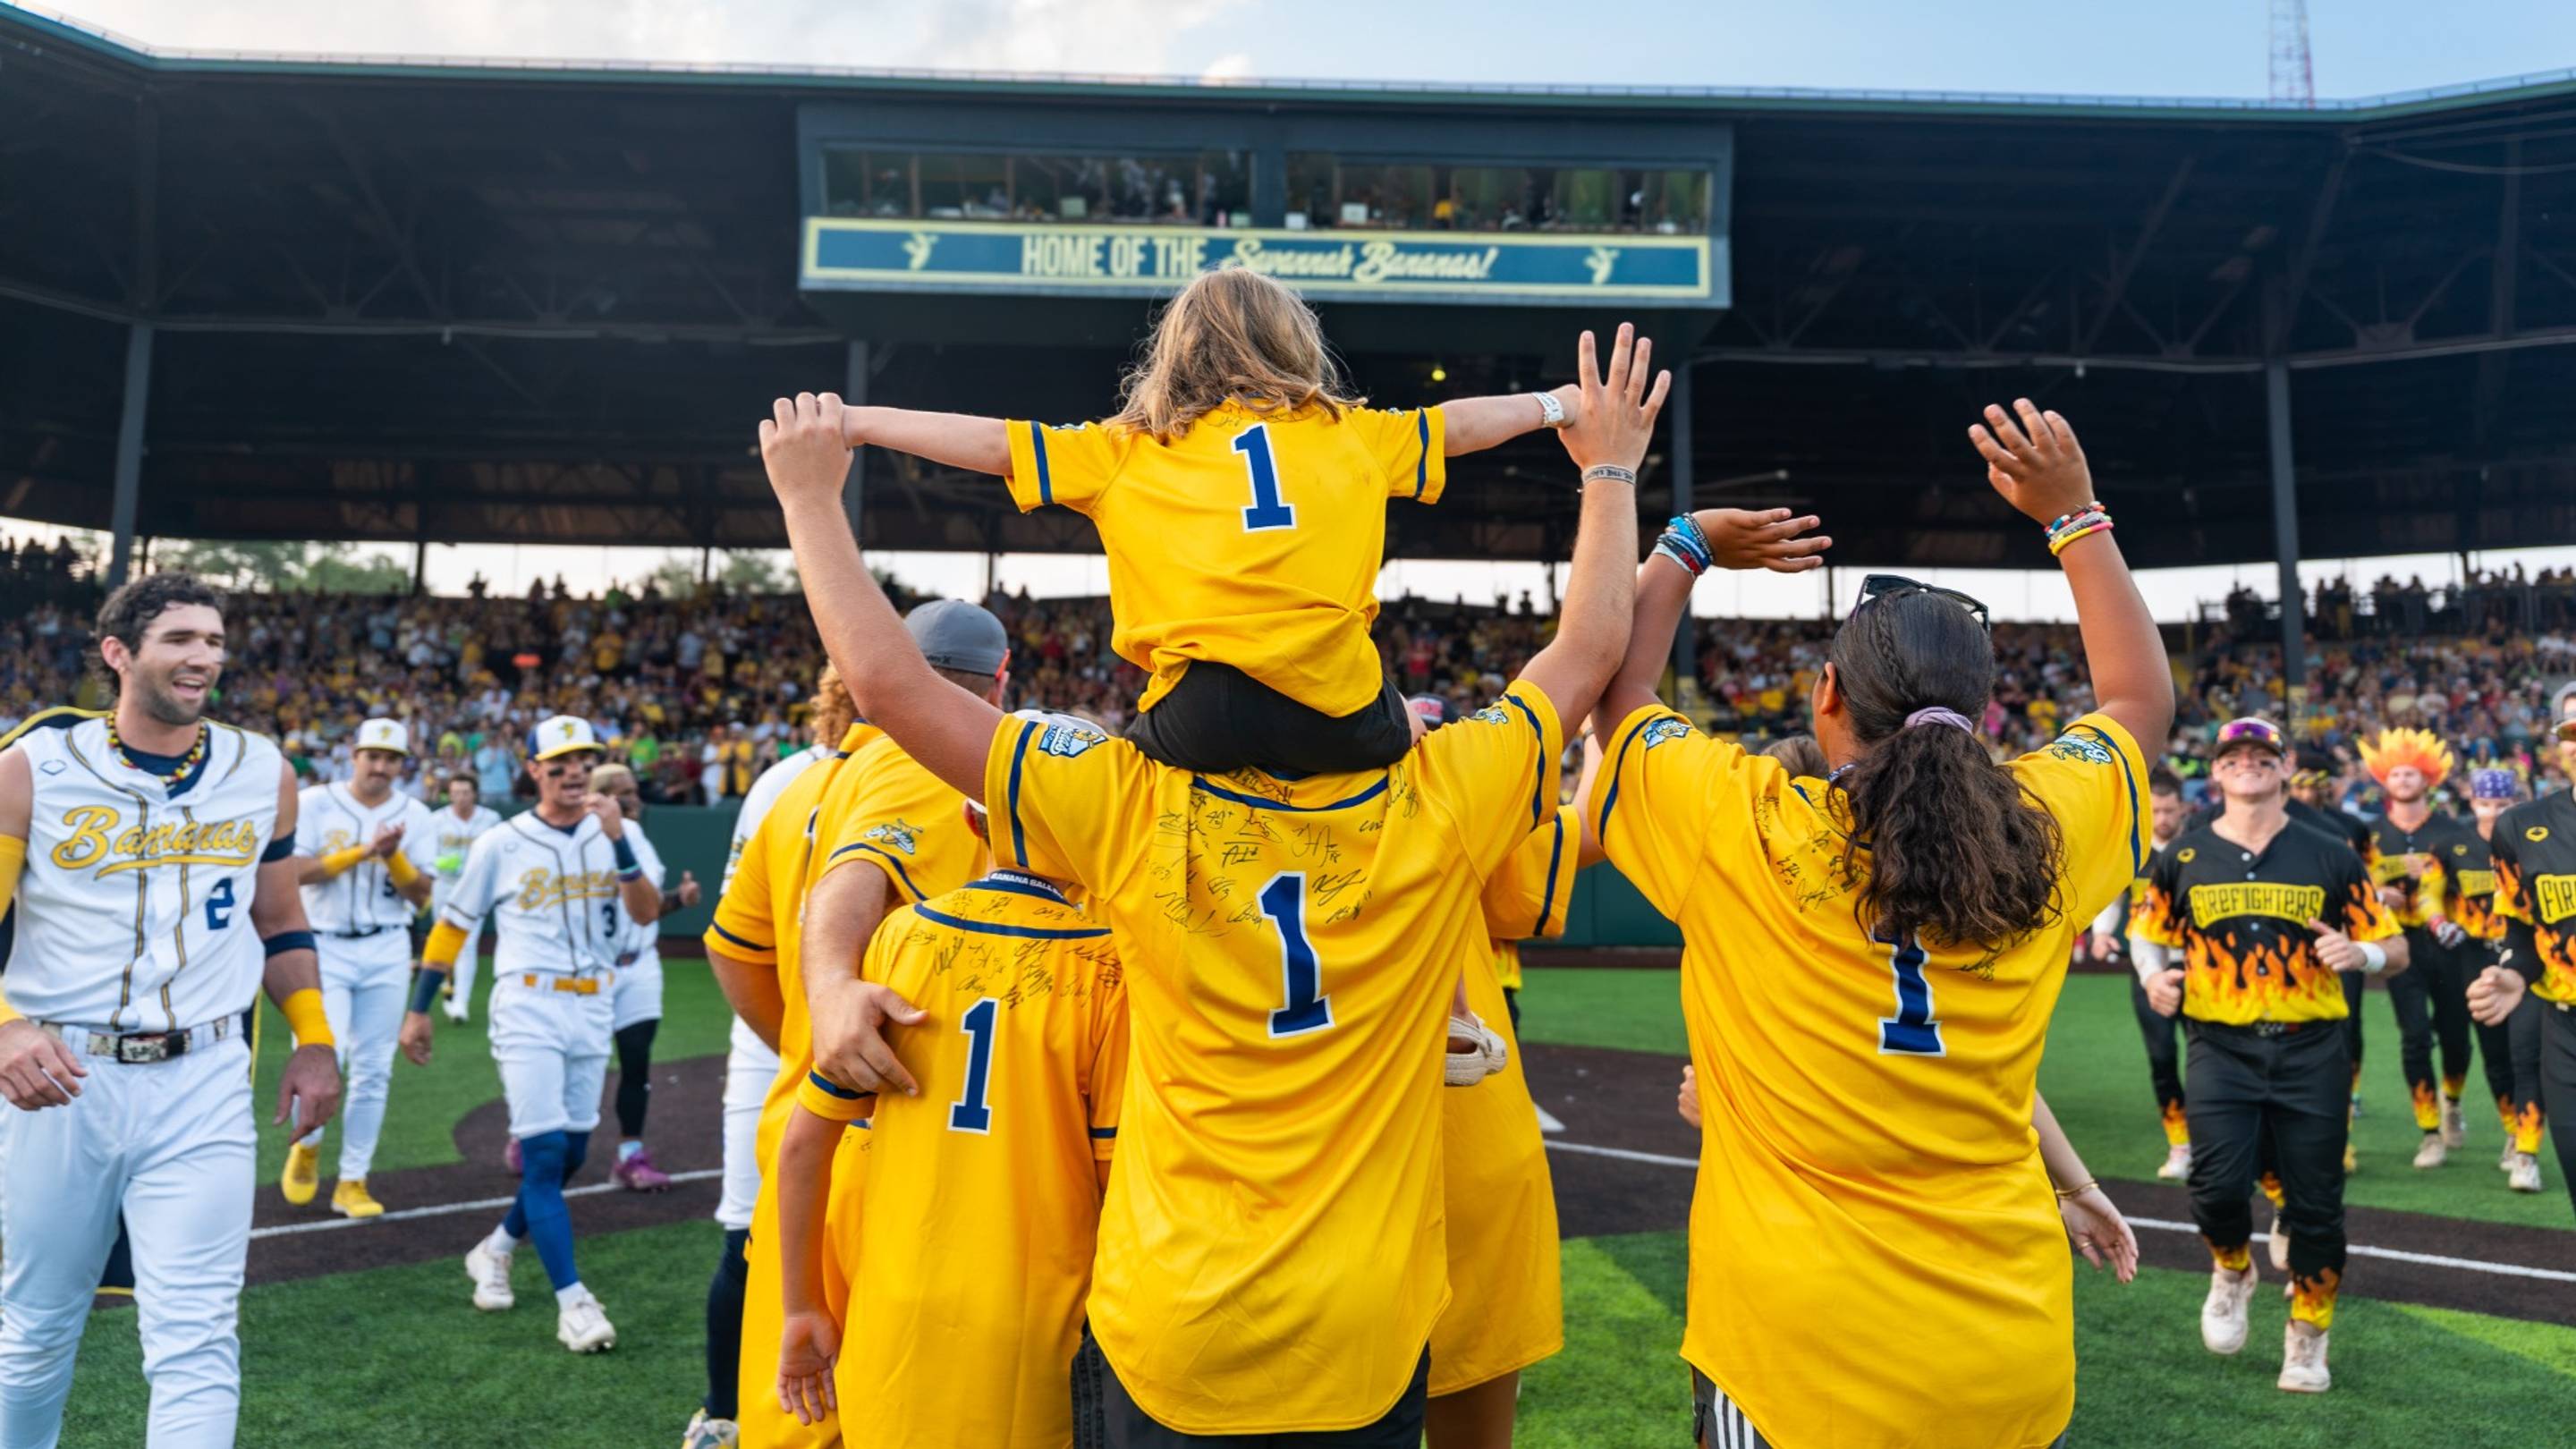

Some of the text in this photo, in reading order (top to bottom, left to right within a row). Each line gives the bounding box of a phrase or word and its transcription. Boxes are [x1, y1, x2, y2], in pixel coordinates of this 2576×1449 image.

[1021, 234, 1499, 284] HOME OF THE Savannah Bananas!
[1231, 423, 1297, 532] 1
[50, 805, 258, 871] Bananas
[206, 877, 234, 930] 2
[602, 902, 616, 938] 3
[2192, 886, 2320, 926] FIREFIGHTERS
[2541, 879, 2576, 919] FIR
[1256, 870, 1335, 1038] 1
[947, 996, 1000, 1136] 1
